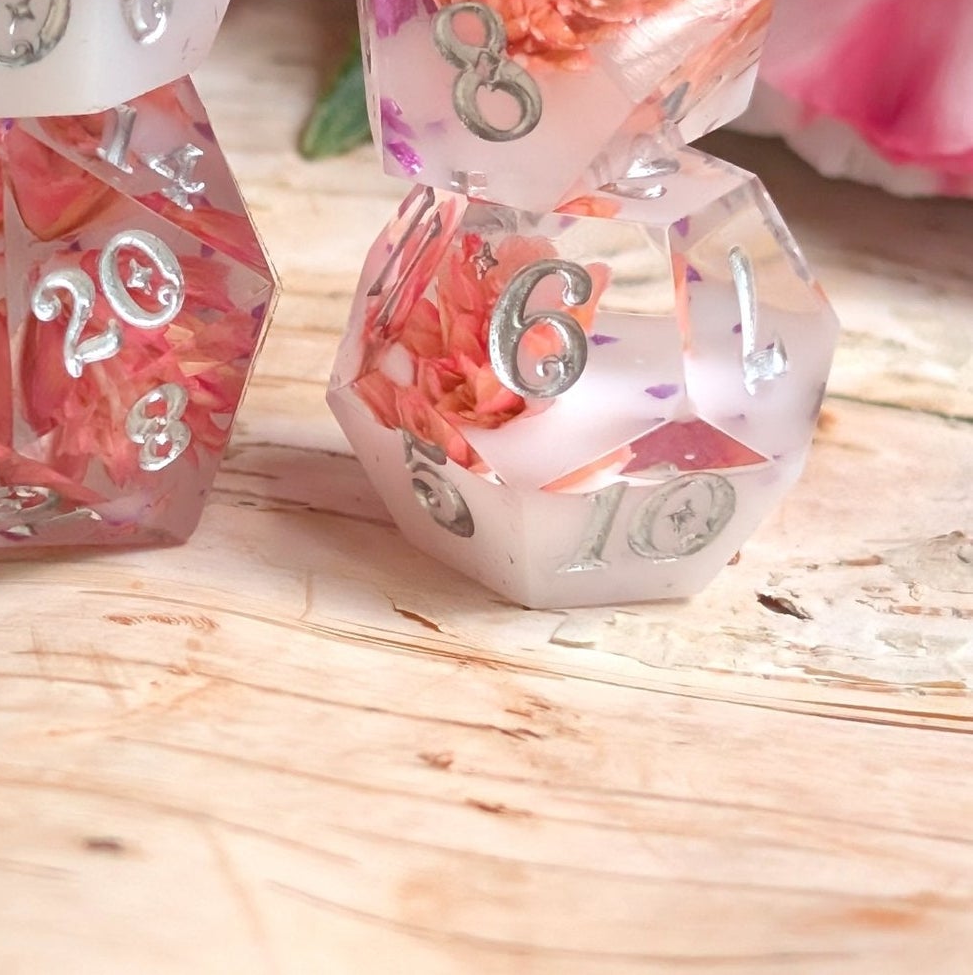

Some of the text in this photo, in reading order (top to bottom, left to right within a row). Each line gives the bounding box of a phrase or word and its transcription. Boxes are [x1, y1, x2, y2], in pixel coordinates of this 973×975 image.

[433, 1, 543, 142] 8
[96, 103, 205, 212] 14
[31, 229, 185, 378] 20
[489, 258, 593, 399] 6
[728, 246, 788, 396] 1
[126, 383, 192, 472] 8
[556, 472, 737, 573] 10
